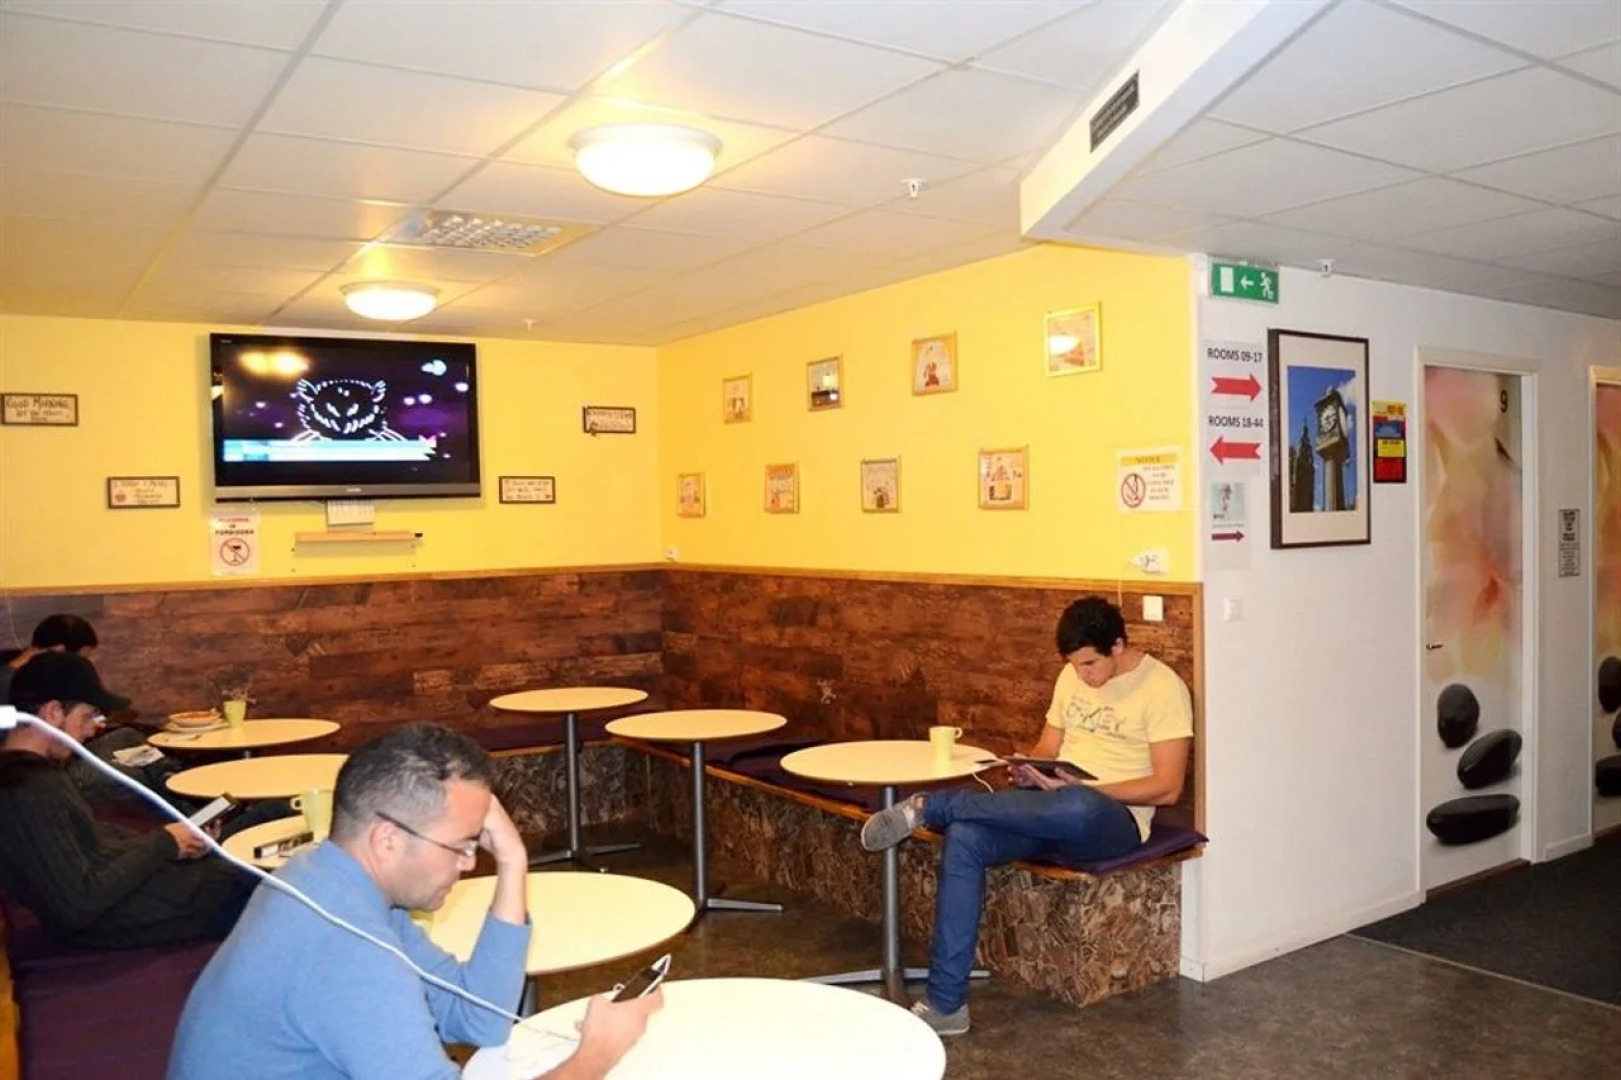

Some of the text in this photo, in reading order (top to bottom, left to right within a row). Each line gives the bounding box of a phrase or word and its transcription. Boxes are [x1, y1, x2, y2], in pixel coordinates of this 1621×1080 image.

[1207, 347, 1263, 363] ROOMS 09-17
[1500, 389, 1508, 414] 9
[1208, 415, 1264, 429] ROOMS 18-44
